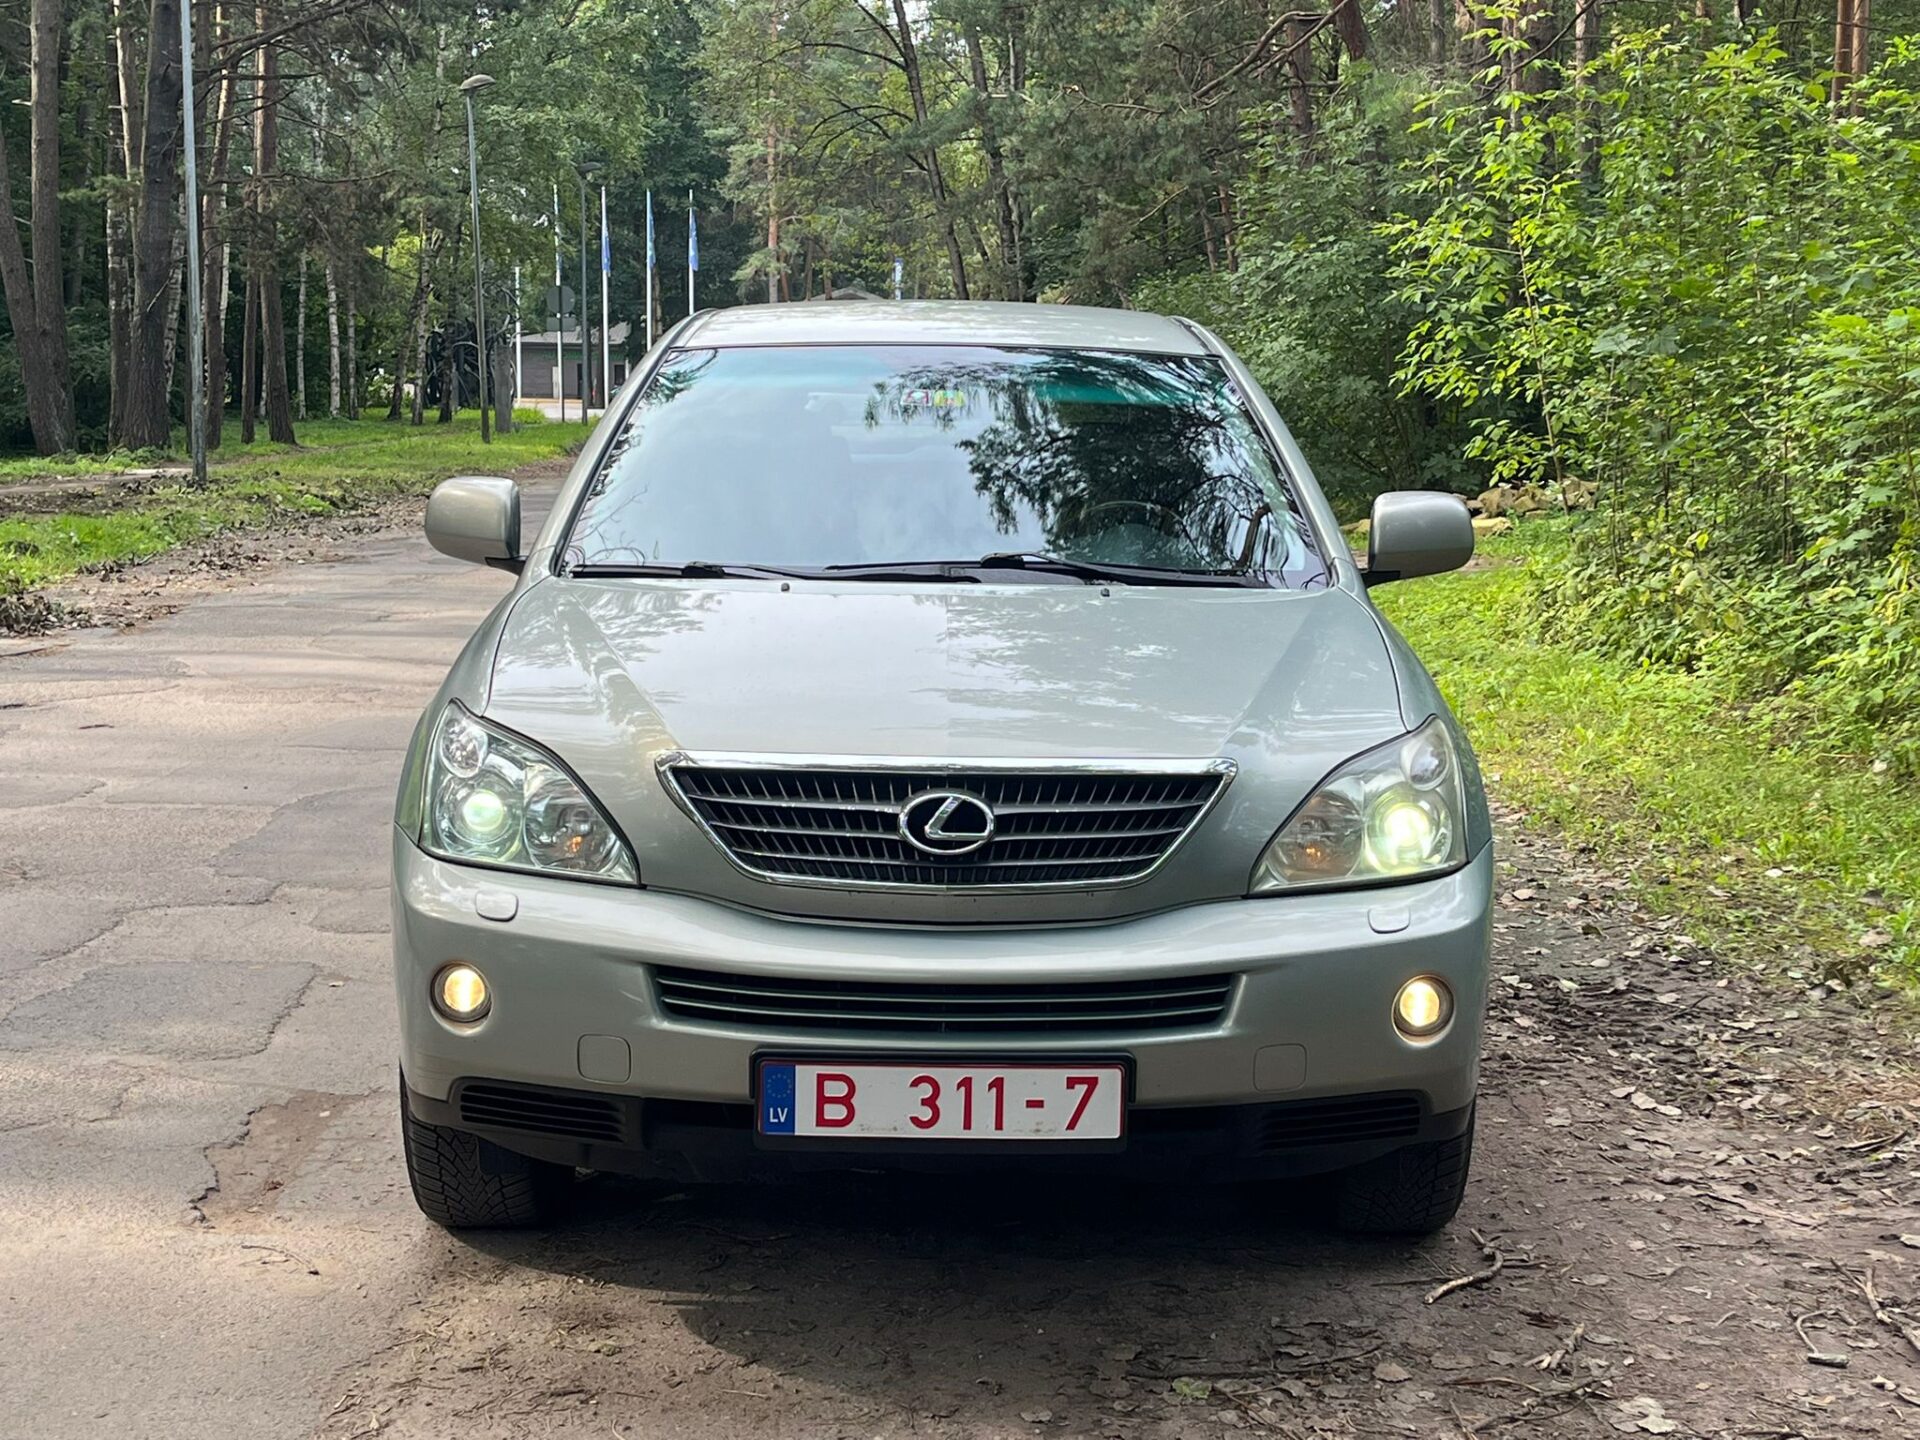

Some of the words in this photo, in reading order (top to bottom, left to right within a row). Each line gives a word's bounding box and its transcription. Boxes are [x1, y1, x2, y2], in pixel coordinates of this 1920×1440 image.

[769, 1107, 788, 1123] LV
[816, 1072, 857, 1128] B
[909, 1074, 1100, 1132] 311-7
